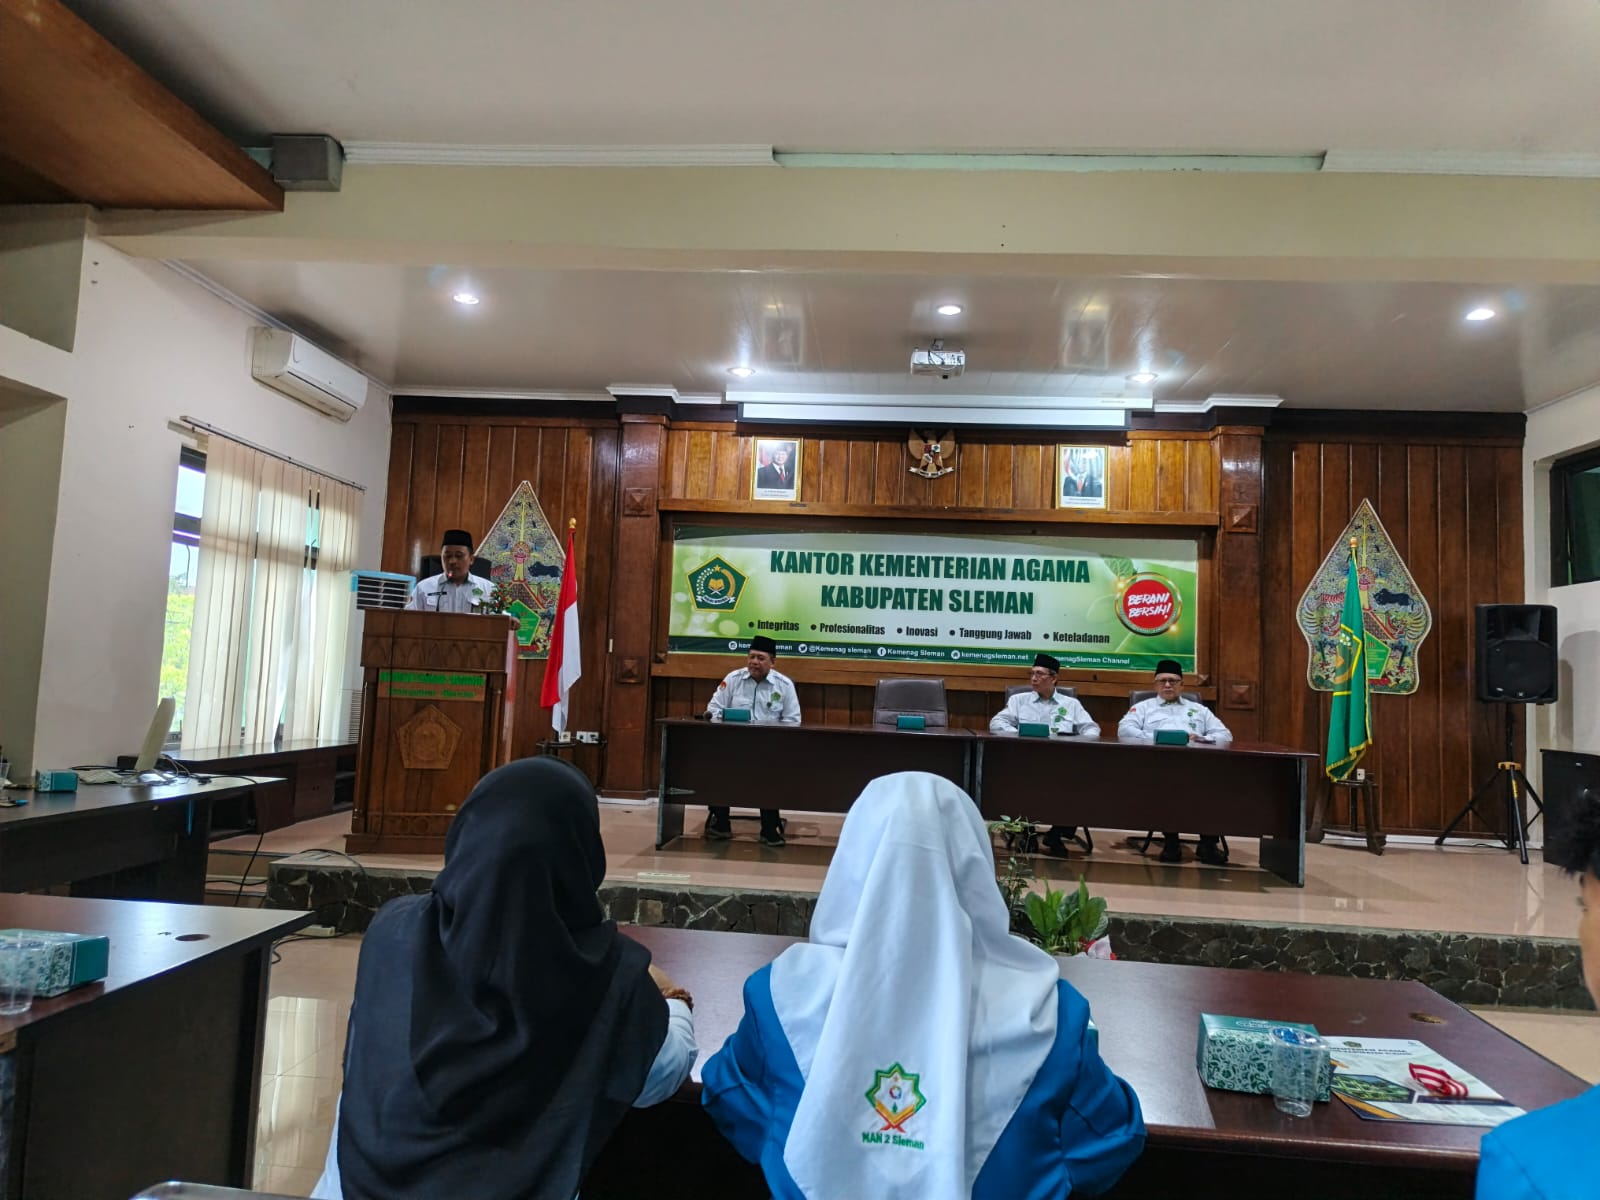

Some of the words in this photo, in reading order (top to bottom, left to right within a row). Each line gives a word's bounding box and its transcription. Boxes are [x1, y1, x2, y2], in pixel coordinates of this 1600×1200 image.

[770, 551, 854, 576] KANTOR
[859, 553, 1006, 580] KEMENTERIAN
[1011, 558, 1090, 583] AGAMA
[821, 585, 943, 612] KABUPATEN
[949, 589, 1034, 615] SLEMAN
[1127, 592, 1170, 607] BERANI
[1128, 602, 1172, 620] BERSIH!
[757, 619, 800, 632] Integritas
[819, 622, 886, 636] Profesionalitas
[906, 626, 938, 637] Inovasi
[959, 627, 1003, 640] Tanggung
[1004, 630, 1032, 641] Jawab
[1053, 632, 1110, 644] Keteladanan
[861, 1132, 883, 1144] MAN
[884, 1134, 890, 1144] 2
[892, 1135, 924, 1150] Sleman
